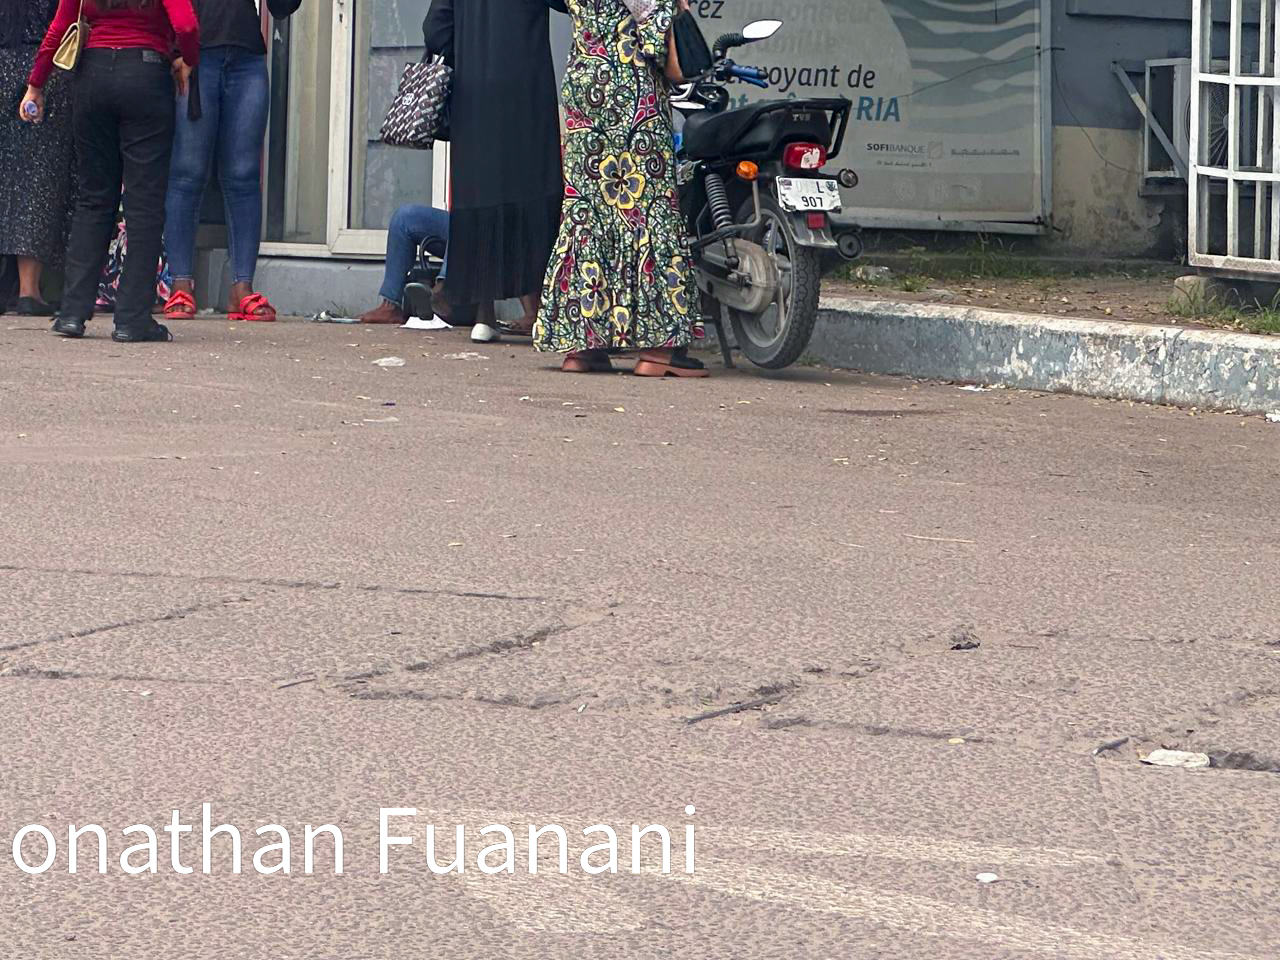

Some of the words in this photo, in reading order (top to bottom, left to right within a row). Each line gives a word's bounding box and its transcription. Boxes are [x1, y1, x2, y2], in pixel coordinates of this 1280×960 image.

[847, 64, 876, 89] de
[856, 96, 901, 122] RIA
[866, 143, 927, 154] SOFIBANQUE
[801, 196, 823, 208] 907
